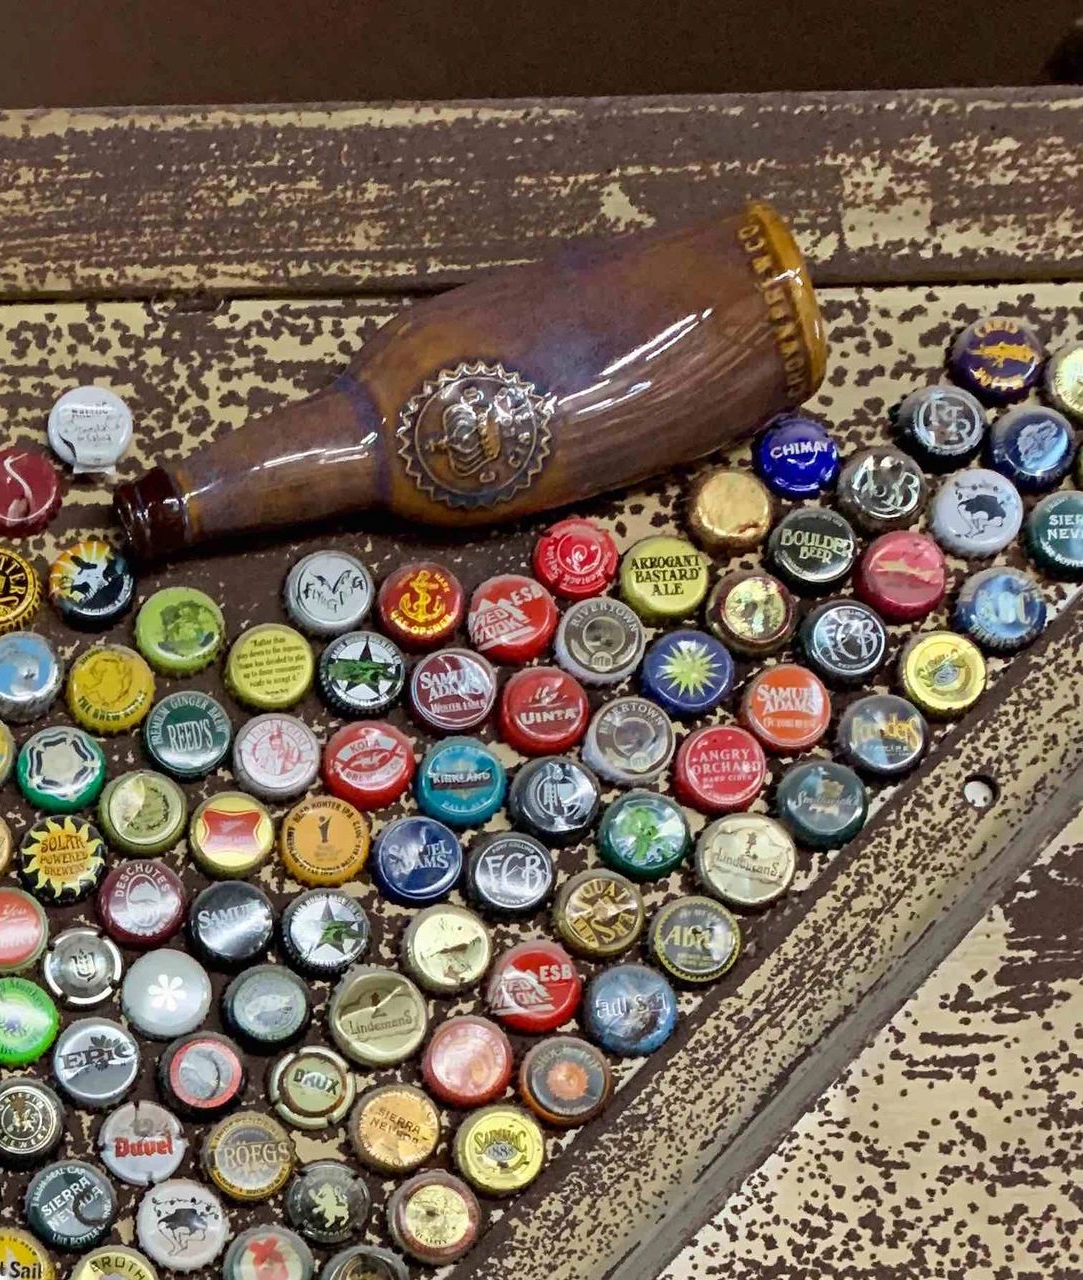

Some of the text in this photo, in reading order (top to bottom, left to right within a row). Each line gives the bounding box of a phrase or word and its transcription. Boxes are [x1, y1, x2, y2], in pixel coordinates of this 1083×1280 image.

[770, 441, 827, 458] CHIMAY
[780, 528, 854, 556] BOULDER
[630, 554, 700, 570] ARROGANT
[799, 547, 832, 565] BEER
[635, 567, 700, 582] BASTARD
[511, 584, 543, 606] ESB
[651, 583, 685, 596] ALE
[570, 602, 640, 634] RIVERTOWN
[77, 690, 148, 722] THE BREW KETTLE
[170, 695, 208, 710] GINGER
[763, 699, 820, 715] ADAMS
[520, 708, 579, 725] UINTA
[167, 718, 214, 753] REED'S
[700, 748, 750, 762] ANGRY
[432, 767, 491, 784] KIRKLAND
[691, 760, 761, 777] ORCHARD
[40, 834, 86, 854] SOLAR
[40, 851, 88, 866] POWERED
[115, 862, 170, 898] DESCHUTES
[539, 964, 573, 982] ESB
[378, 1107, 421, 1134] SIERRA
[114, 1136, 174, 1158] Duvel
[40, 1176, 92, 1217] SIERRA
[9, 1261, 43, 1279] Sail
